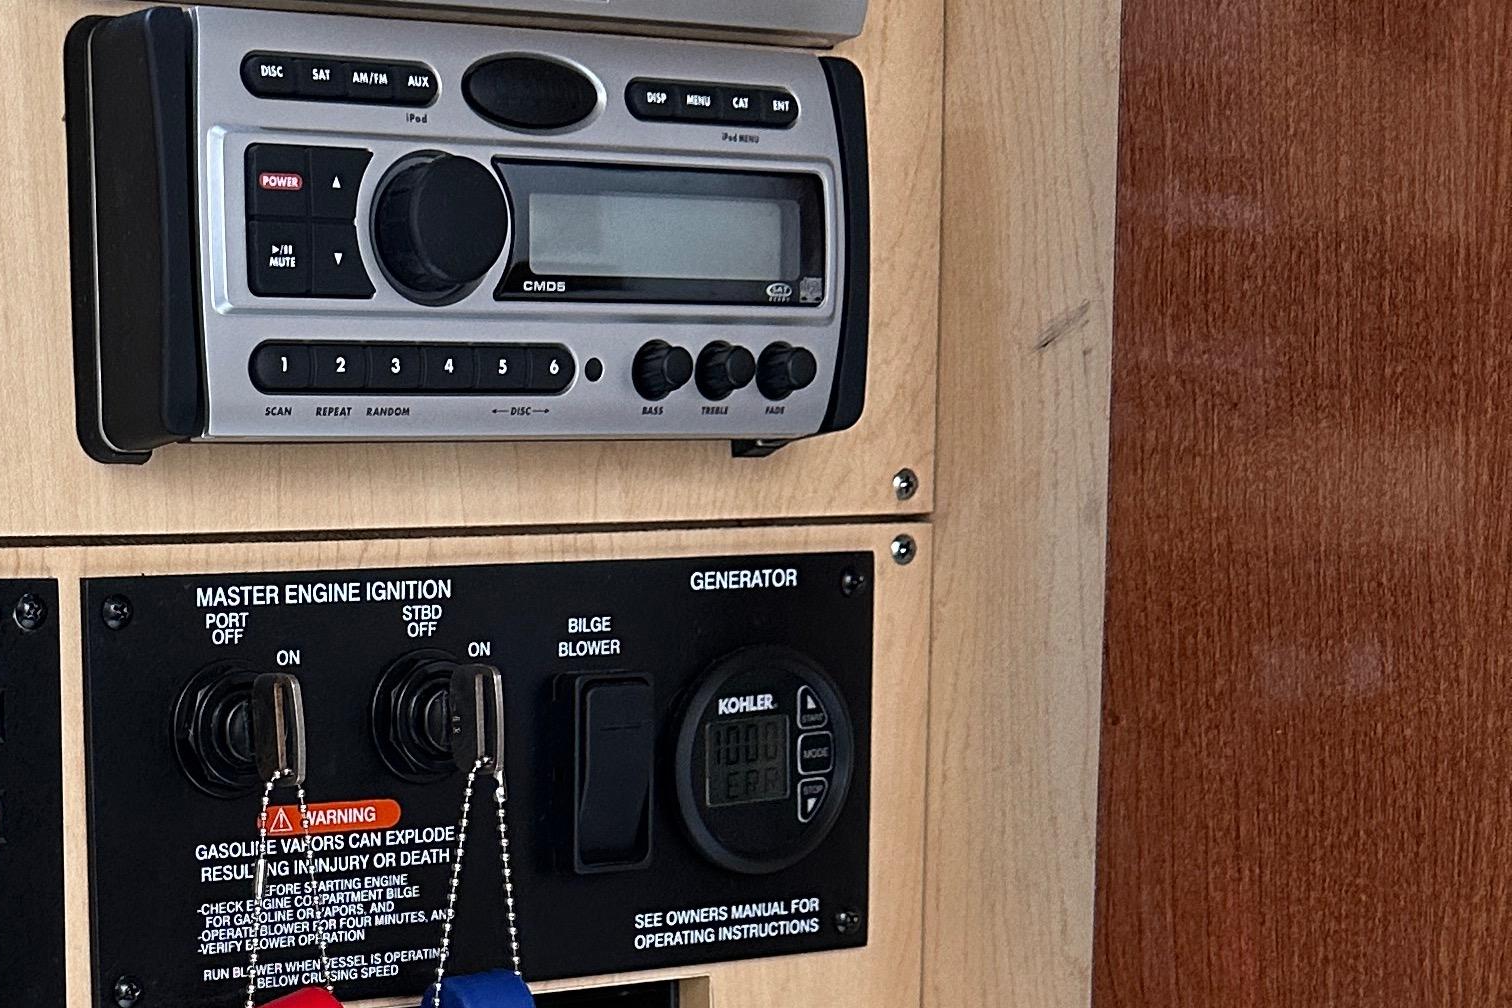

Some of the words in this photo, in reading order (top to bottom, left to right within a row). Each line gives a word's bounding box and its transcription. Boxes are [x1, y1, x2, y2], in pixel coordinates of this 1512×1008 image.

[261, 65, 283, 78] DISC
[312, 69, 330, 81] SAT
[352, 72, 388, 85] AM/FM
[408, 75, 429, 88] AUX
[647, 92, 666, 104] DISP
[687, 94, 711, 107] MENU
[732, 97, 749, 109] CAT
[773, 100, 789, 112] ENT
[262, 175, 298, 188] POWER
[269, 256, 296, 268] MUTE
[281, 356, 288, 372] 1
[336, 356, 346, 373] 2
[391, 357, 401, 374] 3
[444, 358, 454, 374] 4
[498, 359, 507, 375] 5
[549, 360, 559, 375] 6
[265, 406, 292, 416] SCAN
[315, 406, 352, 417] REPEAT
[366, 406, 410, 416] RANDOM
[510, 406, 532, 416] DISC
[641, 406, 664, 416] BASS
[701, 406, 729, 416] TREBLE
[765, 406, 786, 416] FADE
[690, 568, 798, 591] GENERATOR
[196, 585, 279, 607] MASTER
[285, 582, 361, 605] ENGINE
[366, 579, 452, 602] IGNITION
[205, 612, 249, 629] PORT
[402, 605, 442, 621] STBD
[407, 621, 438, 638] OFF
[568, 616, 612, 633] BILGE
[211, 629, 244, 645] OFF
[468, 642, 491, 657] ON
[558, 639, 621, 657] BLOWER
[276, 650, 300, 666] ON
[718, 693, 774, 715] KOHLER
[305, 806, 376, 826] WARNING
[348, 831, 381, 849] CAN
[385, 826, 455, 846] EXPLODE
[201, 860, 289, 882] RESULNG
[373, 852, 396, 868] OR
[400, 848, 450, 866] DEATH
[364, 874, 408, 889] ENGINE
[294, 889, 384, 907] COPARTMENT
[386, 886, 420, 900] BILGE
[205, 915, 230, 928] FOR
[296, 908, 314, 920] OR
[370, 901, 394, 914] AND
[635, 912, 663, 929] SEE
[666, 906, 728, 927] OWNERS
[731, 901, 788, 920] MANUAL
[791, 897, 820, 914] FOR
[260, 921, 309, 936] BLOWER
[339, 915, 372, 930] FOUR
[375, 910, 428, 926] MINUTES,
[635, 927, 715, 950] OPERATING
[718, 918, 820, 942] INSTRUCTIONS
[203, 968, 229, 981] RUN
[285, 959, 320, 973] WHEN
[370, 953, 381, 965] IS
[257, 974, 299, 989] BELOW
[361, 964, 399, 979] SPEED
